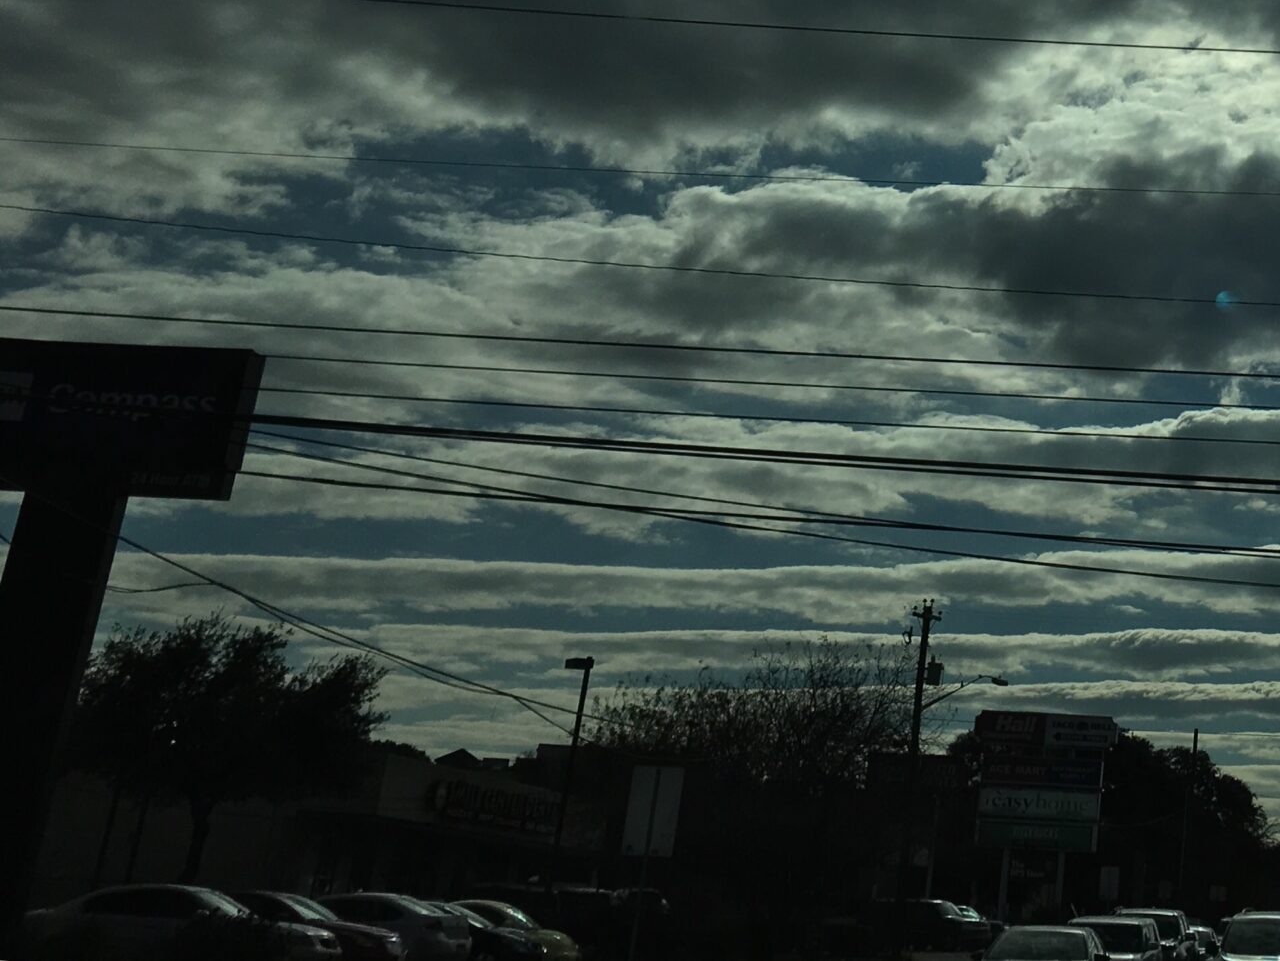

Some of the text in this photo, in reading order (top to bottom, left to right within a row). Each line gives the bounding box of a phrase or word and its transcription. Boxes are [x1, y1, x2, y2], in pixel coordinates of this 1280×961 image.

[48, 382, 217, 421] Compass
[995, 715, 1038, 733] Hall
[1015, 766, 1047, 777] MART
[991, 791, 1091, 814] easyhome
